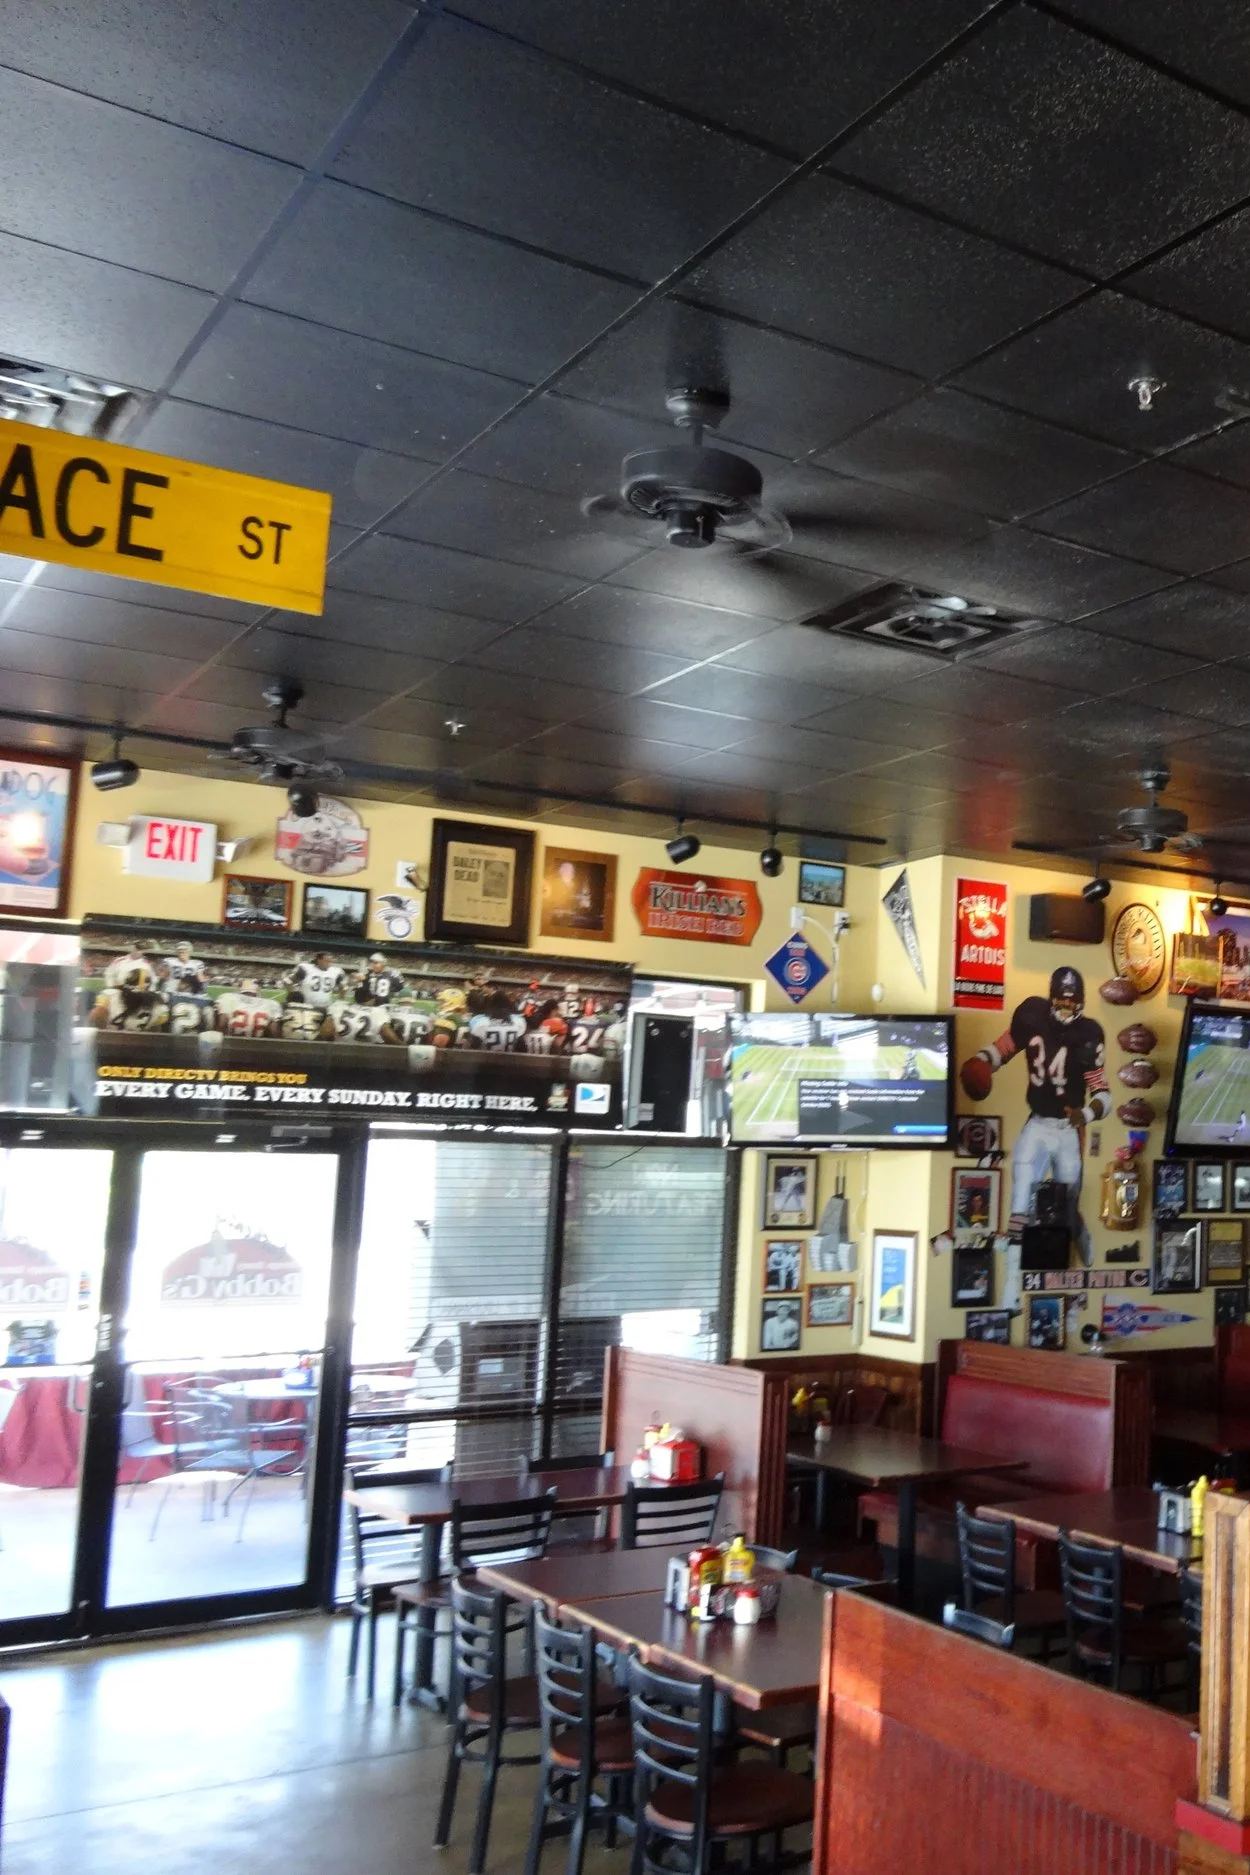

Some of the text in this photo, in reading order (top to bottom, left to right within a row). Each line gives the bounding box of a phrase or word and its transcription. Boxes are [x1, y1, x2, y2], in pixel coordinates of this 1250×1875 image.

[238, 516, 292, 565] ST
[146, 822, 203, 864] EXIT
[959, 894, 1009, 917] STELLA
[648, 912, 746, 937] IRISH RED
[960, 944, 1006, 966] ARTOIS
[97, 1065, 308, 1084] ONLY DIRECTV BRINGS YOU
[1028, 1035, 1069, 1096] 34
[94, 1081, 539, 1113] EVERY GAME. EVERY SUNDAY. RIGHT HERE.
[1024, 1272, 1042, 1291] 34
